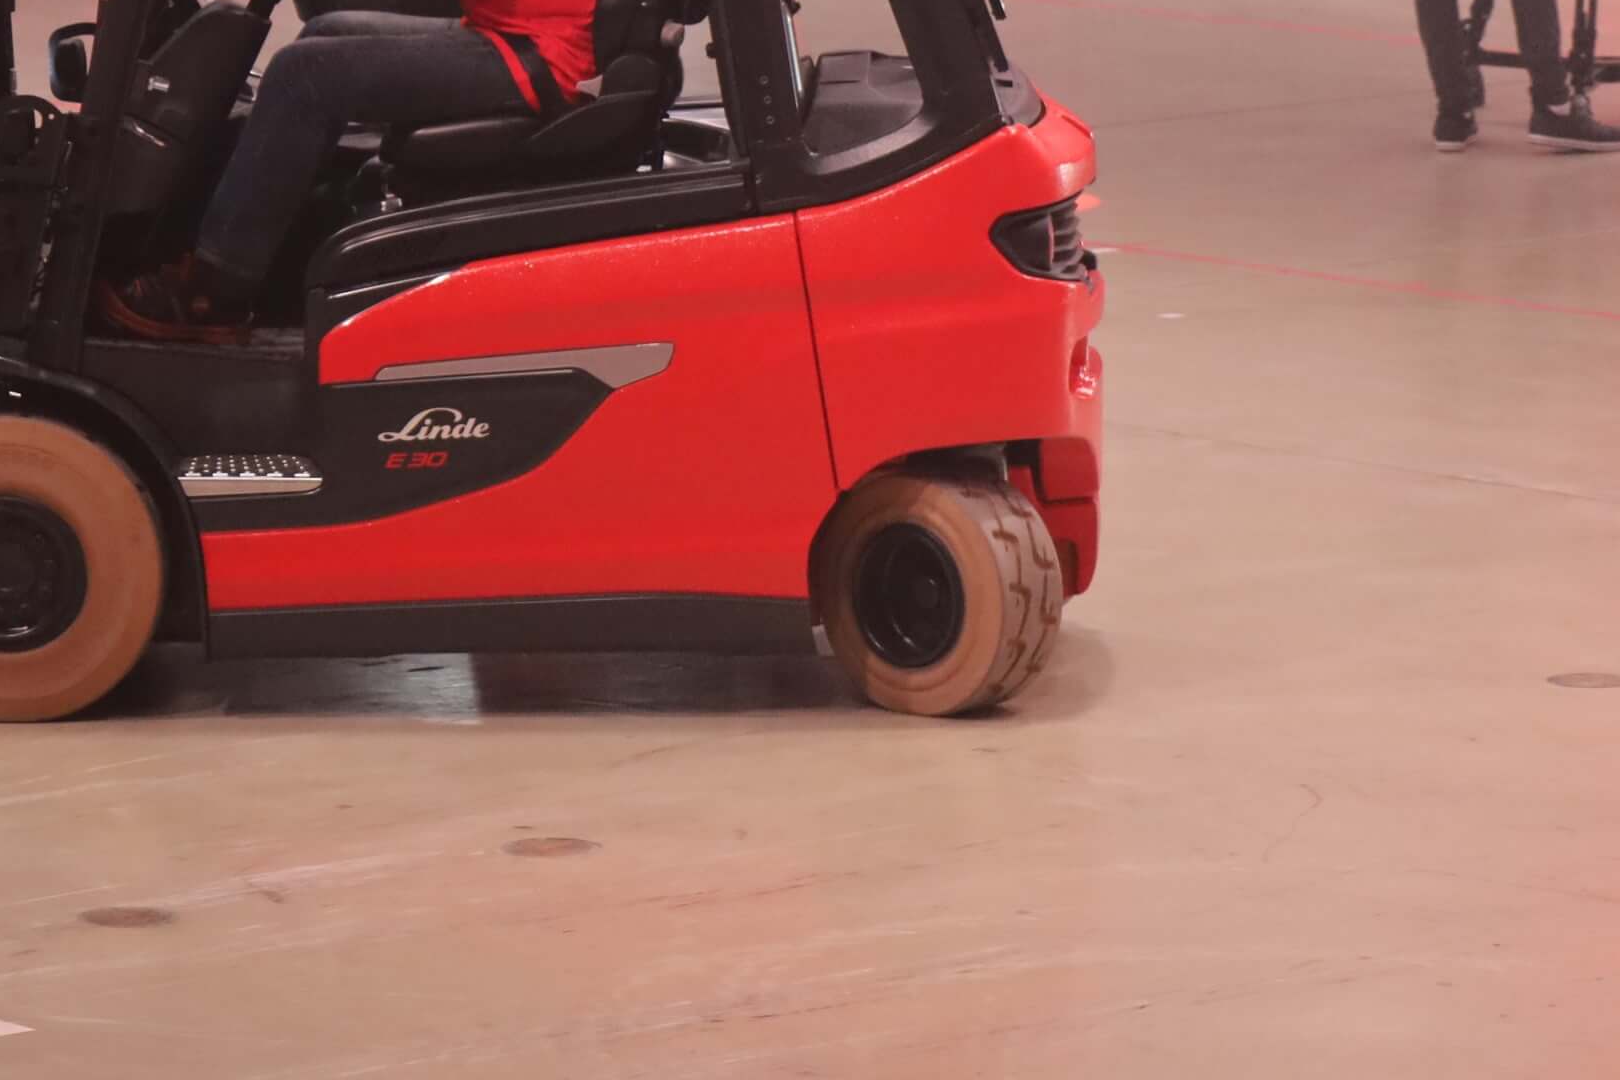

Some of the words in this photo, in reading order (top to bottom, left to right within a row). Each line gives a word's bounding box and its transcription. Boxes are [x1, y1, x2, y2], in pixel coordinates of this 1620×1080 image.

[378, 407, 490, 442] Linde
[385, 452, 407, 469] E
[407, 451, 449, 469] 30
